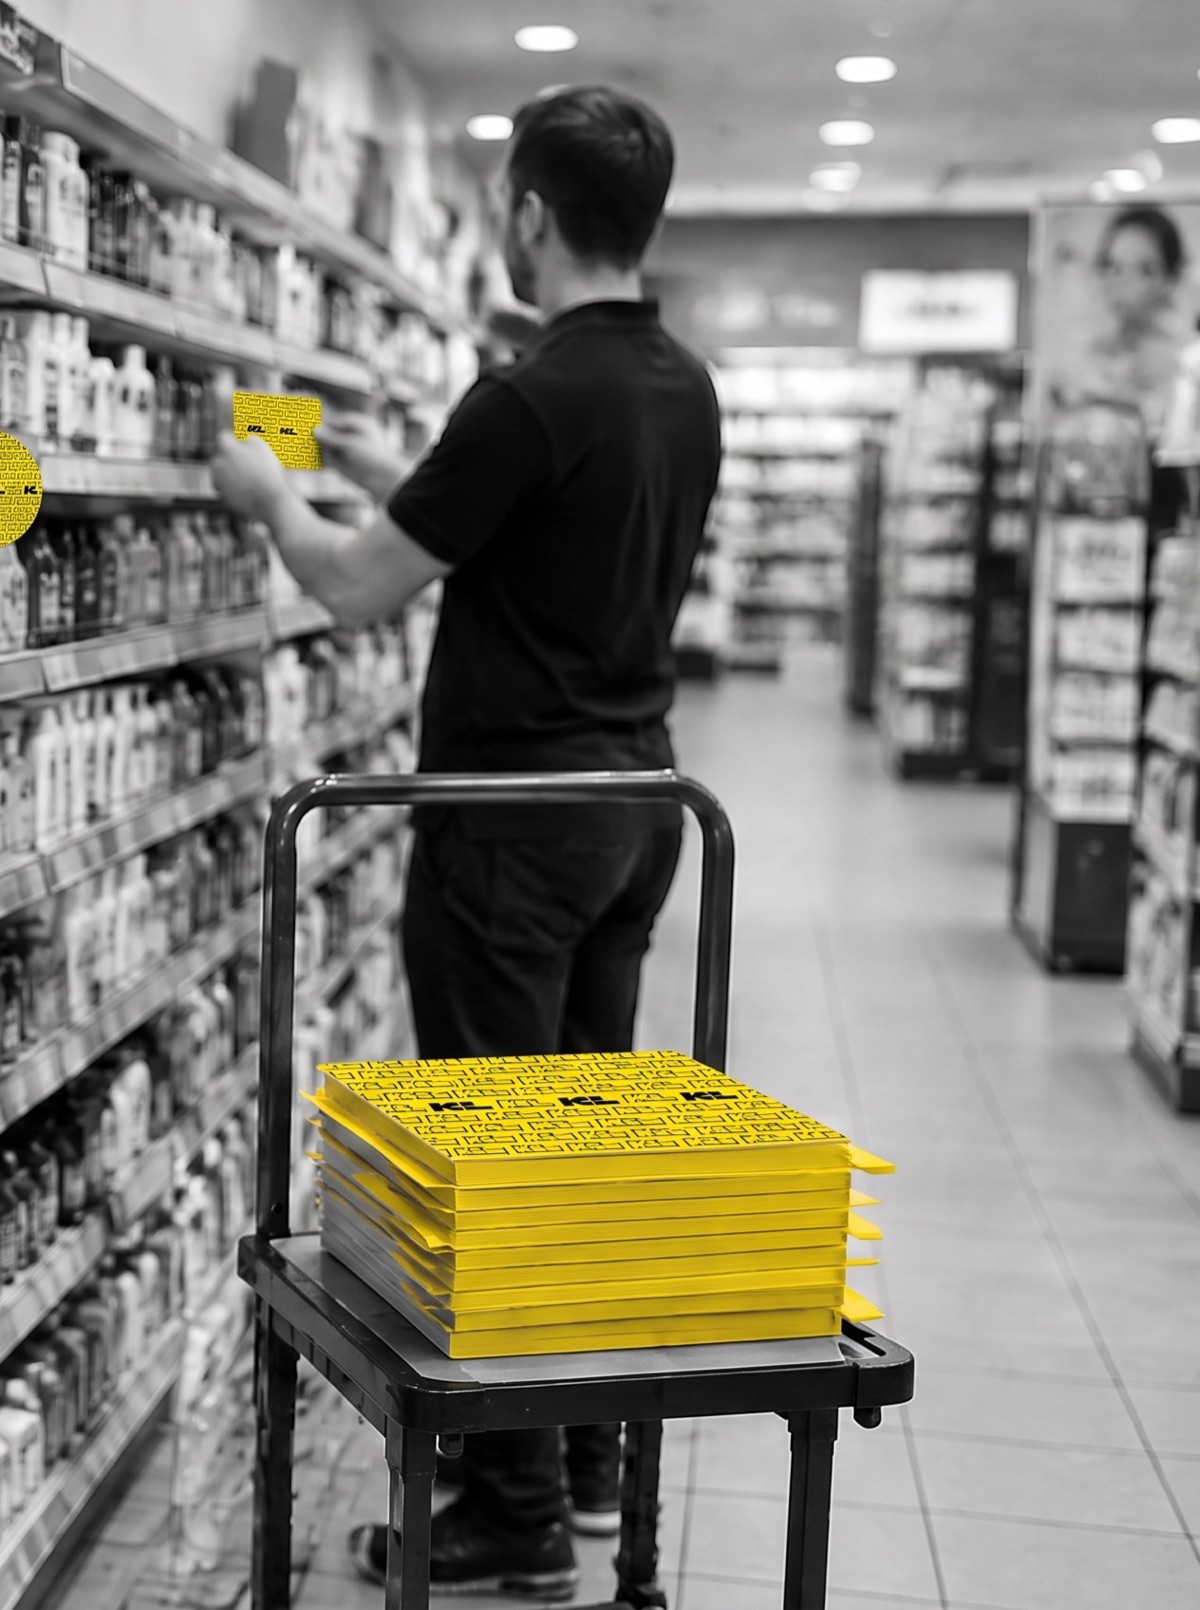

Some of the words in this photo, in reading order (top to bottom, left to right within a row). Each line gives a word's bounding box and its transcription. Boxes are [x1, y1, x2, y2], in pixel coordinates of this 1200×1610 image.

[429, 1101, 494, 1112] KL
[557, 1096, 621, 1106] KL
[680, 1091, 739, 1101] KL
